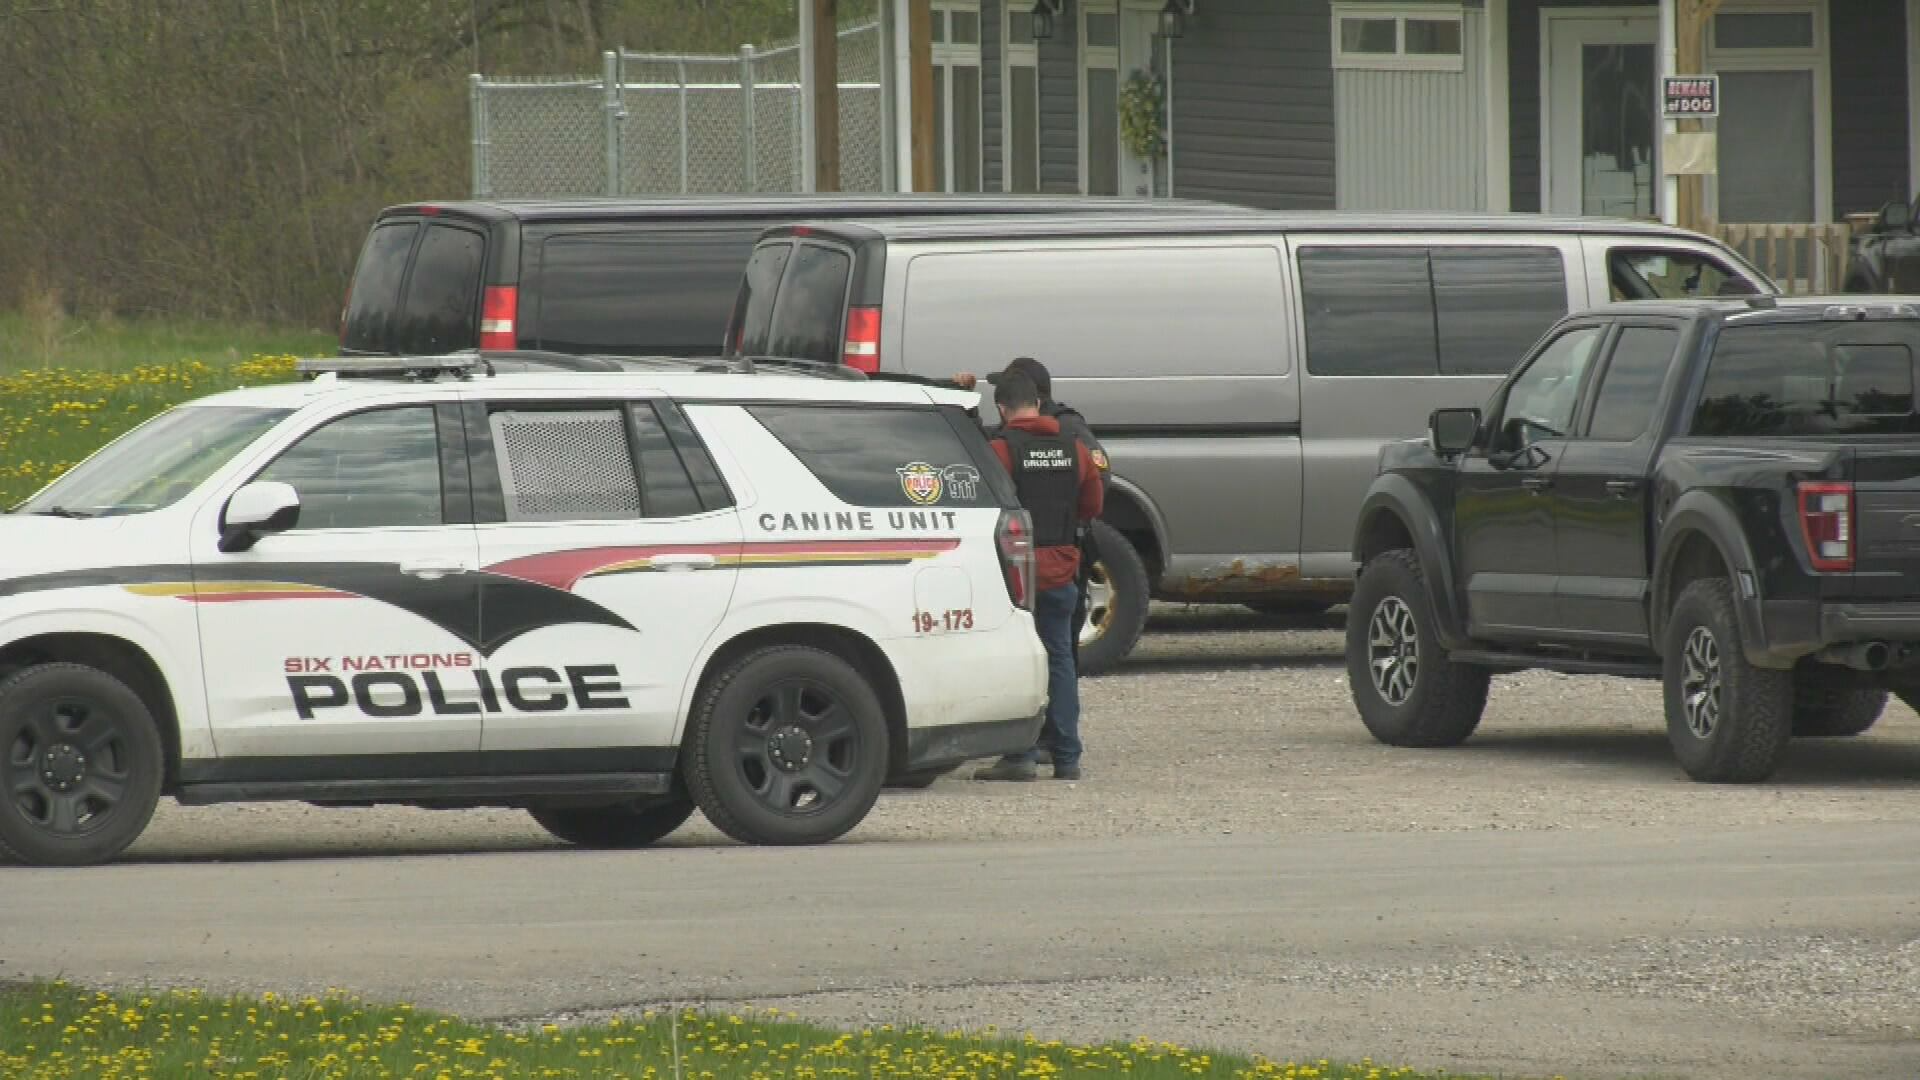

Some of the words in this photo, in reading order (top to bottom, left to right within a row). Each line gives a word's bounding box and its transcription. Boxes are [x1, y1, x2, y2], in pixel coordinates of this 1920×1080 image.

[1680, 98, 1712, 111] DOG
[1023, 459, 1050, 468] DRUG
[1051, 458, 1072, 467] UNIT
[1030, 449, 1063, 459] POLICE
[950, 480, 977, 499] 911
[759, 512, 873, 531] CANINE
[888, 511, 957, 530] UNIT
[284, 657, 331, 673] SIX
[342, 653, 473, 671] NATIONS
[286, 663, 632, 720] POLICE
